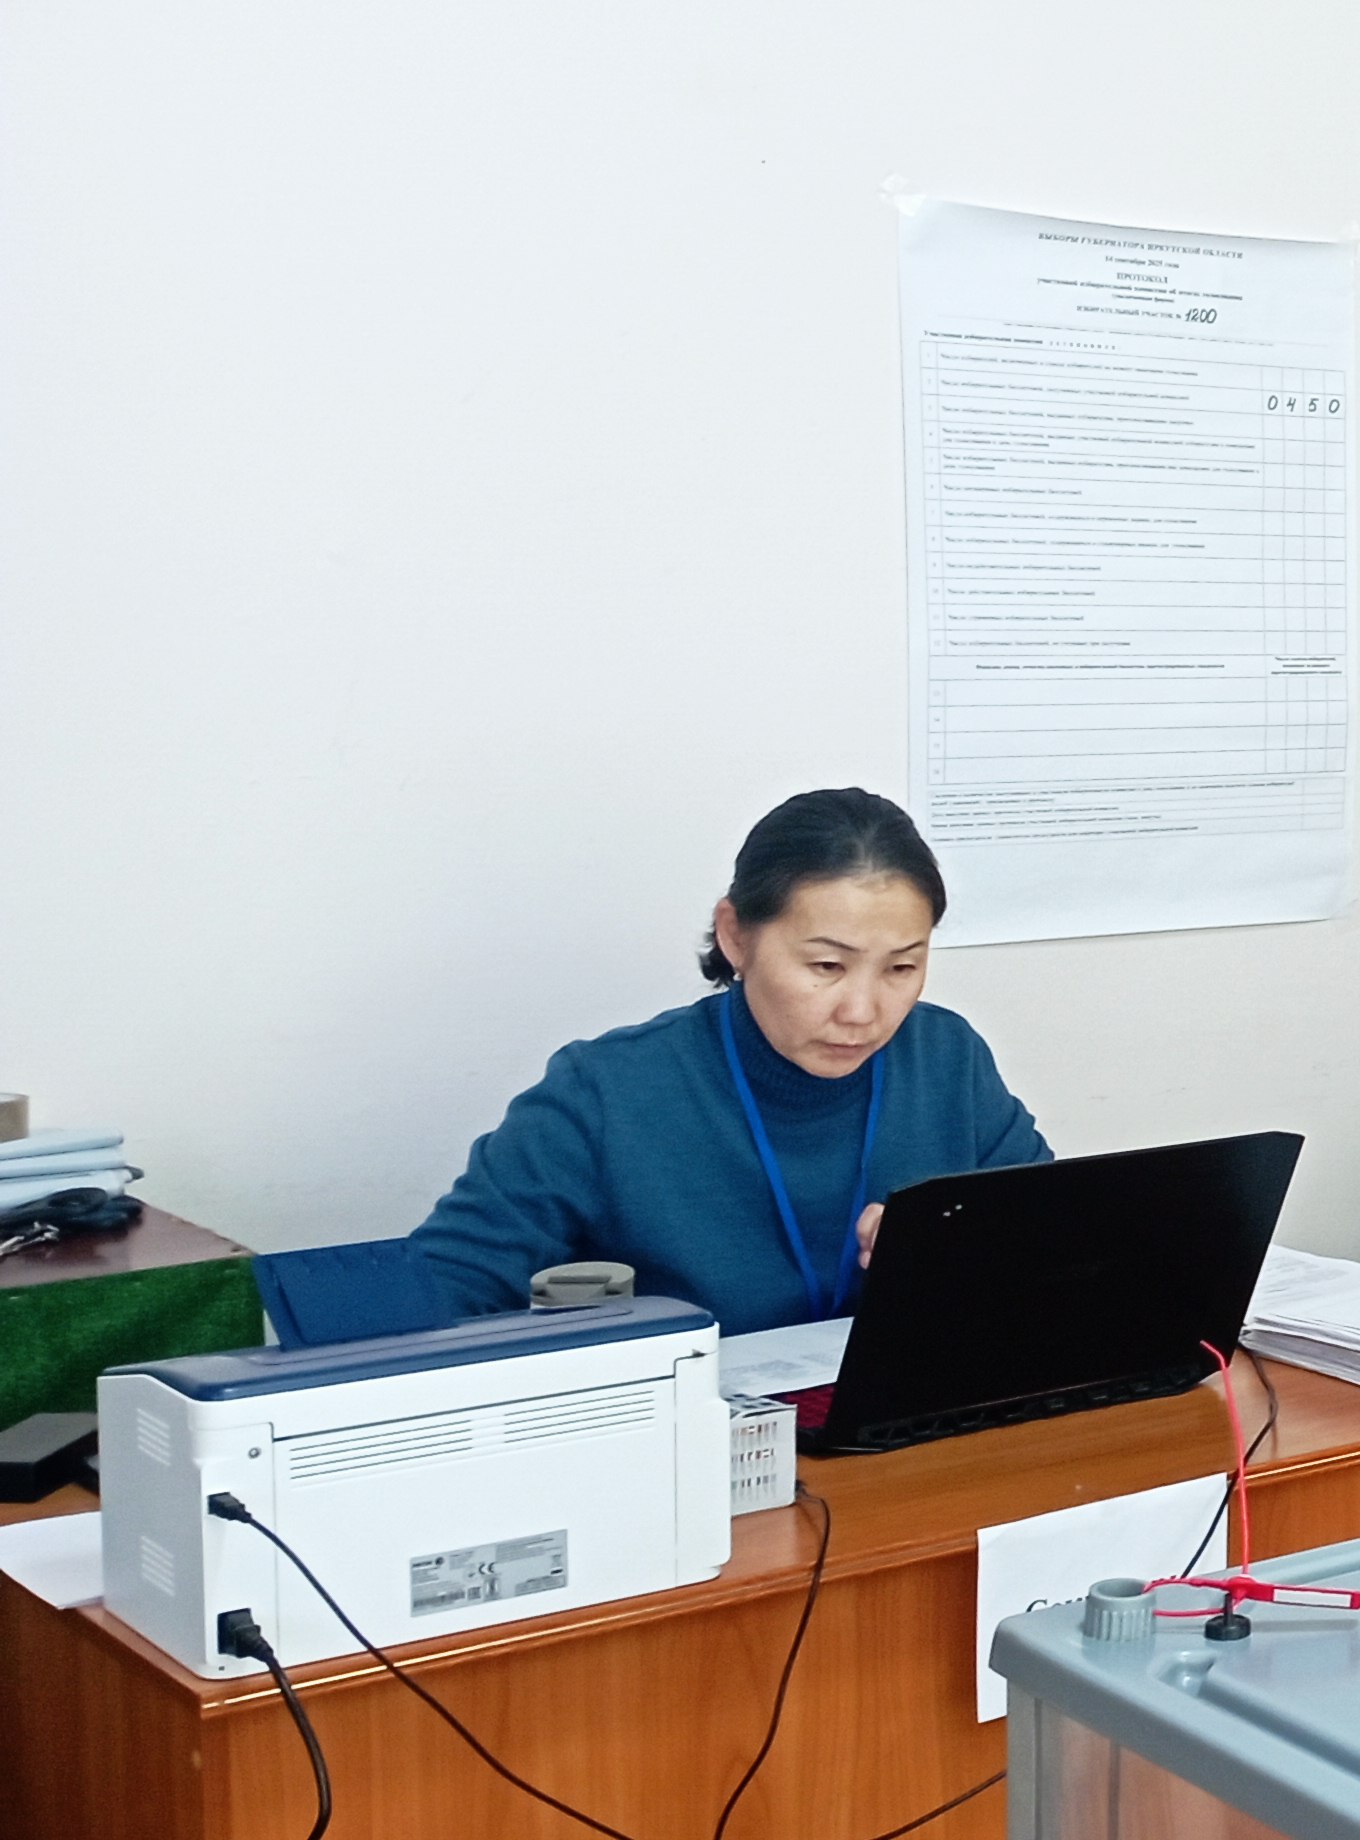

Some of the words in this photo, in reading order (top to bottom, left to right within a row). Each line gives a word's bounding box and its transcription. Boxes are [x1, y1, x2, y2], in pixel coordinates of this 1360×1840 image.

[1184, 308, 1218, 324] 1200
[1267, 395, 1279, 411] 0
[1286, 397, 1297, 412] 4
[1308, 398, 1320, 412] 5
[1328, 398, 1341, 414] 0
